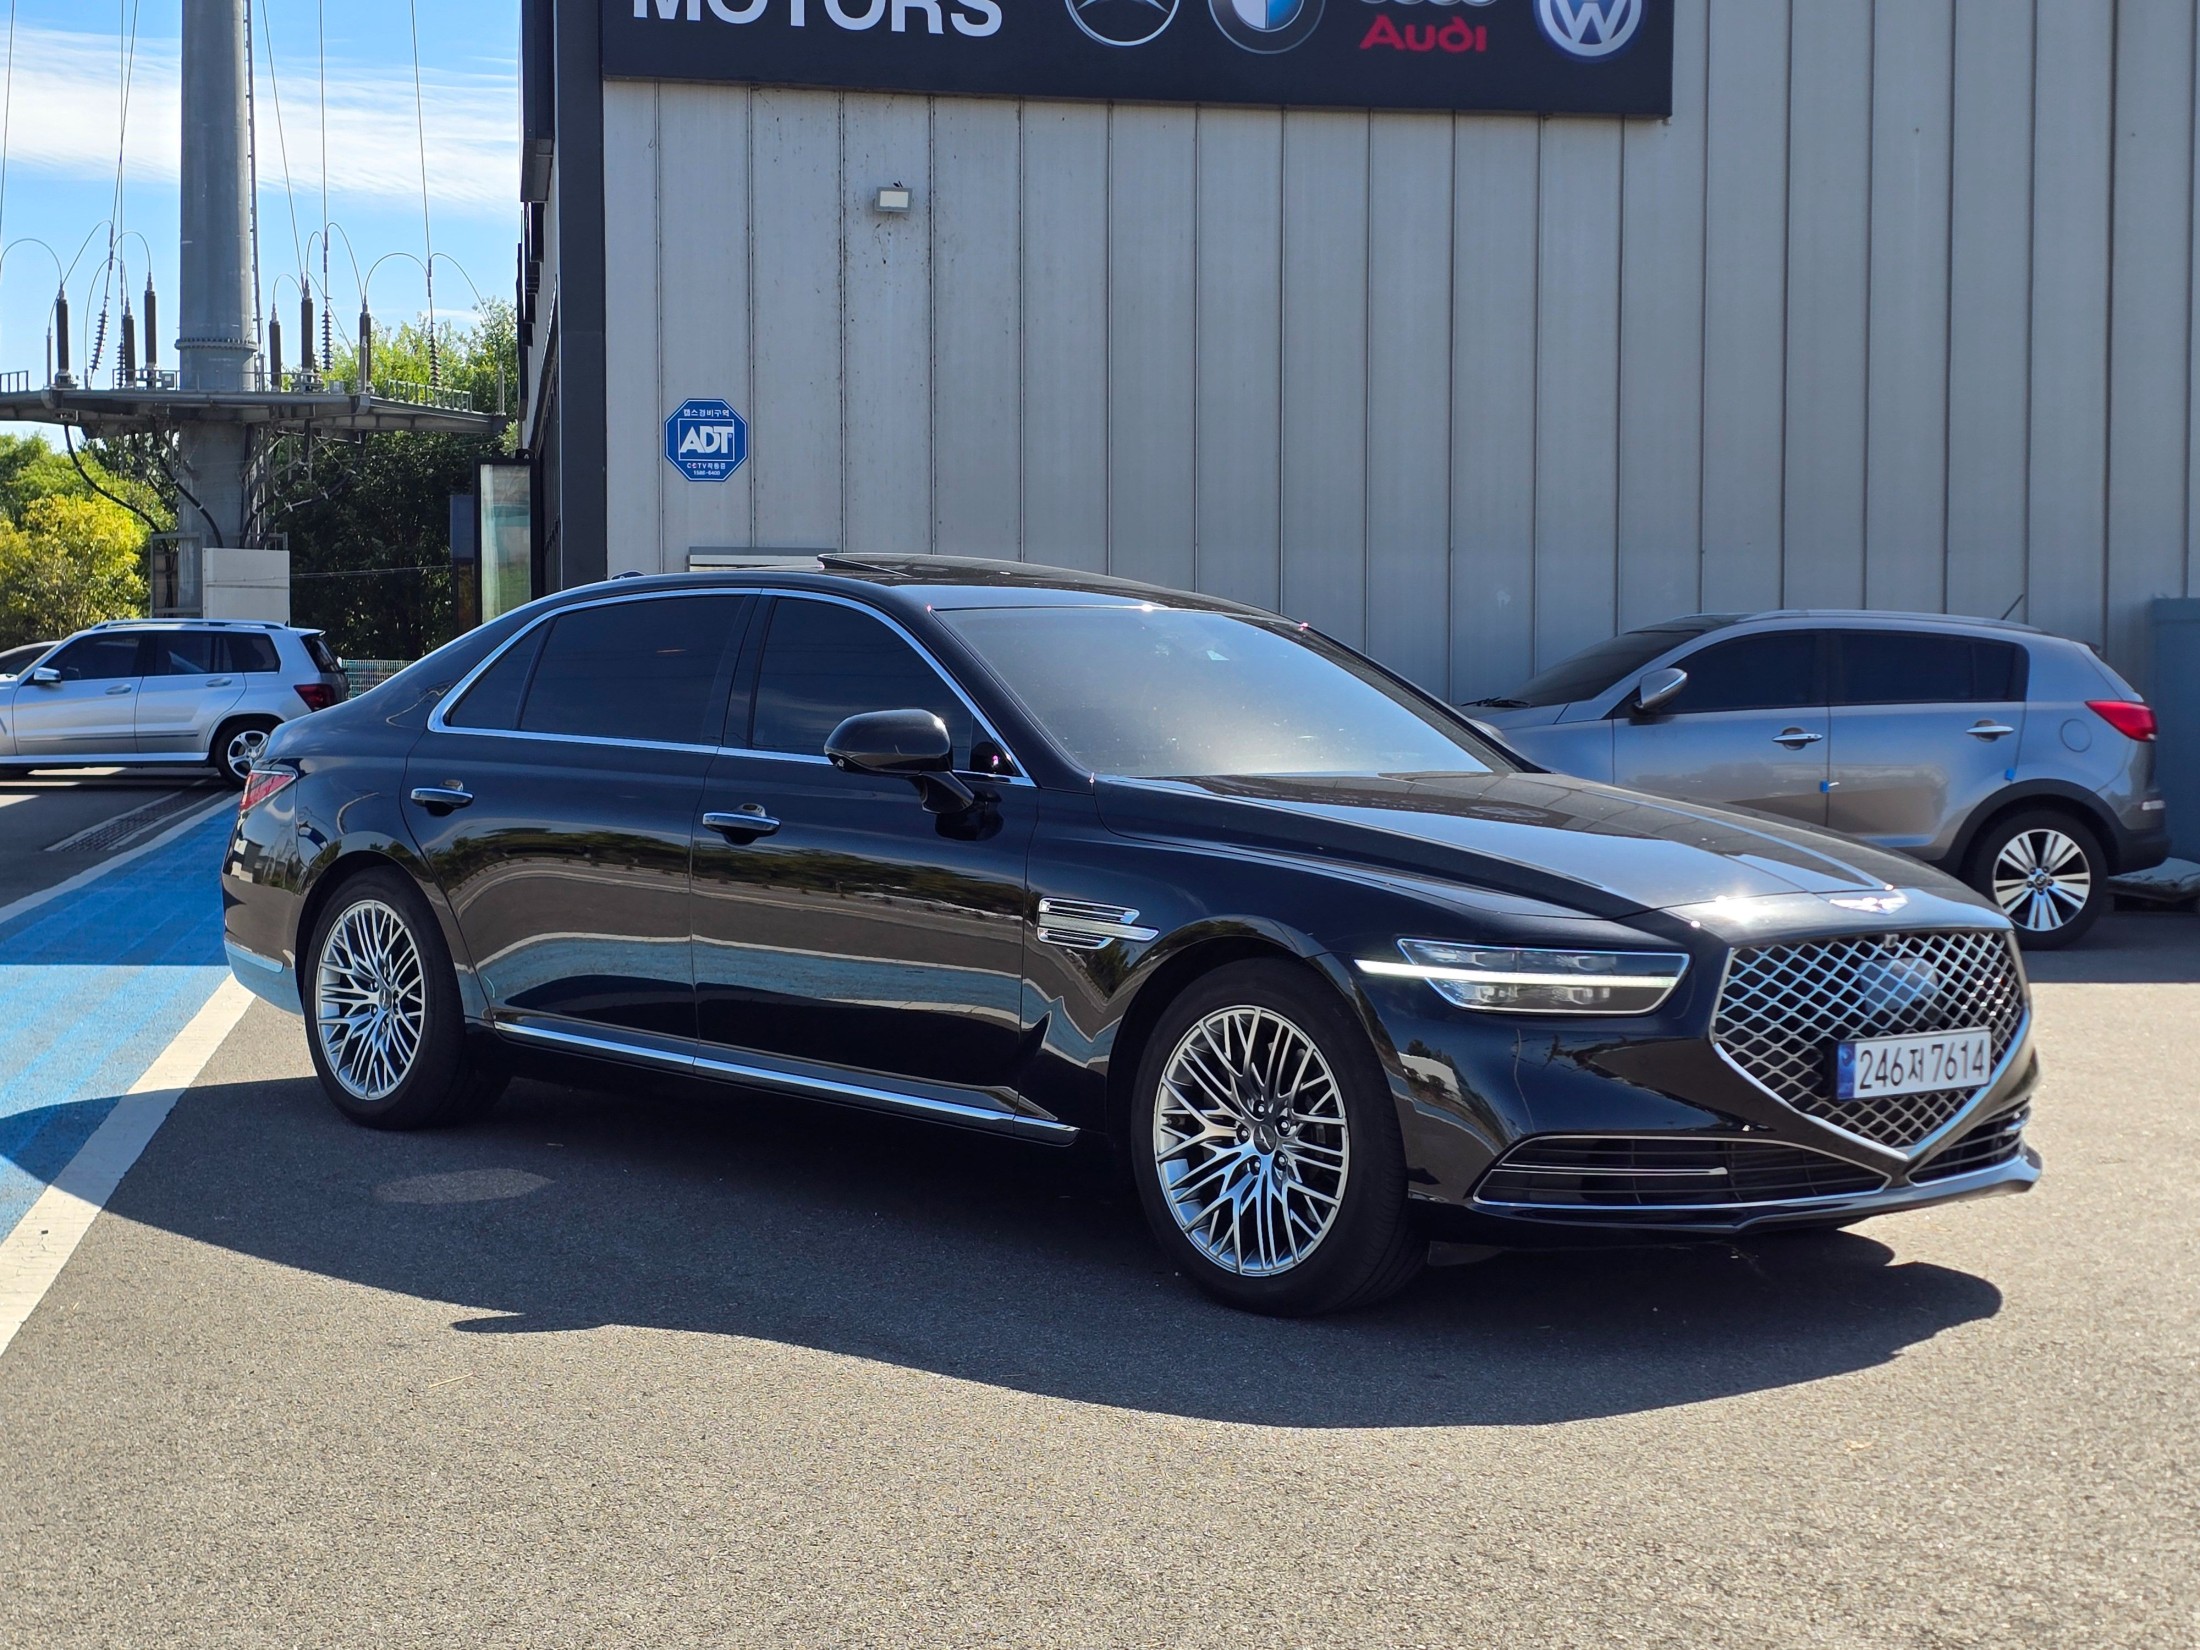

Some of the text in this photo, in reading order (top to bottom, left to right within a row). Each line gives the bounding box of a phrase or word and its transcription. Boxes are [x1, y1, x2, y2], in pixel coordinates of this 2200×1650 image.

[633, 0, 1003, 37] ORS
[1359, 14, 1488, 53] Audi
[680, 425, 734, 454] ADT
